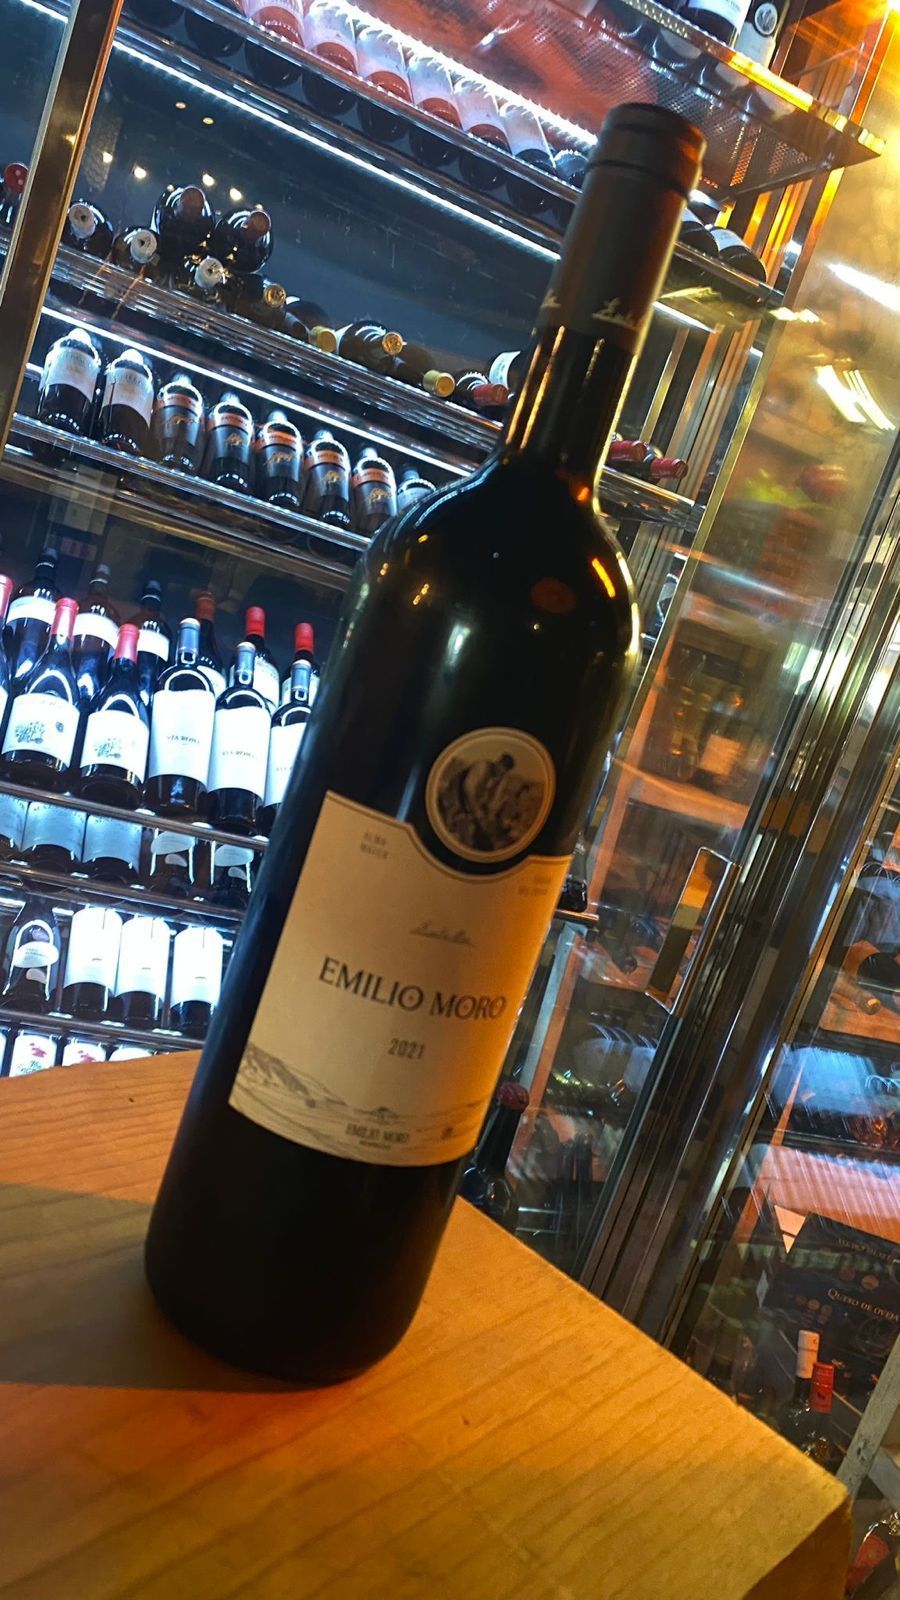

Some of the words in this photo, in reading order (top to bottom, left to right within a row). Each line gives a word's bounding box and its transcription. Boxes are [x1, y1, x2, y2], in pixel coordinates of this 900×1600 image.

[318, 956, 424, 1012] EMILIO
[429, 991, 507, 1020] MORO
[388, 1037, 426, 1060] 2021
